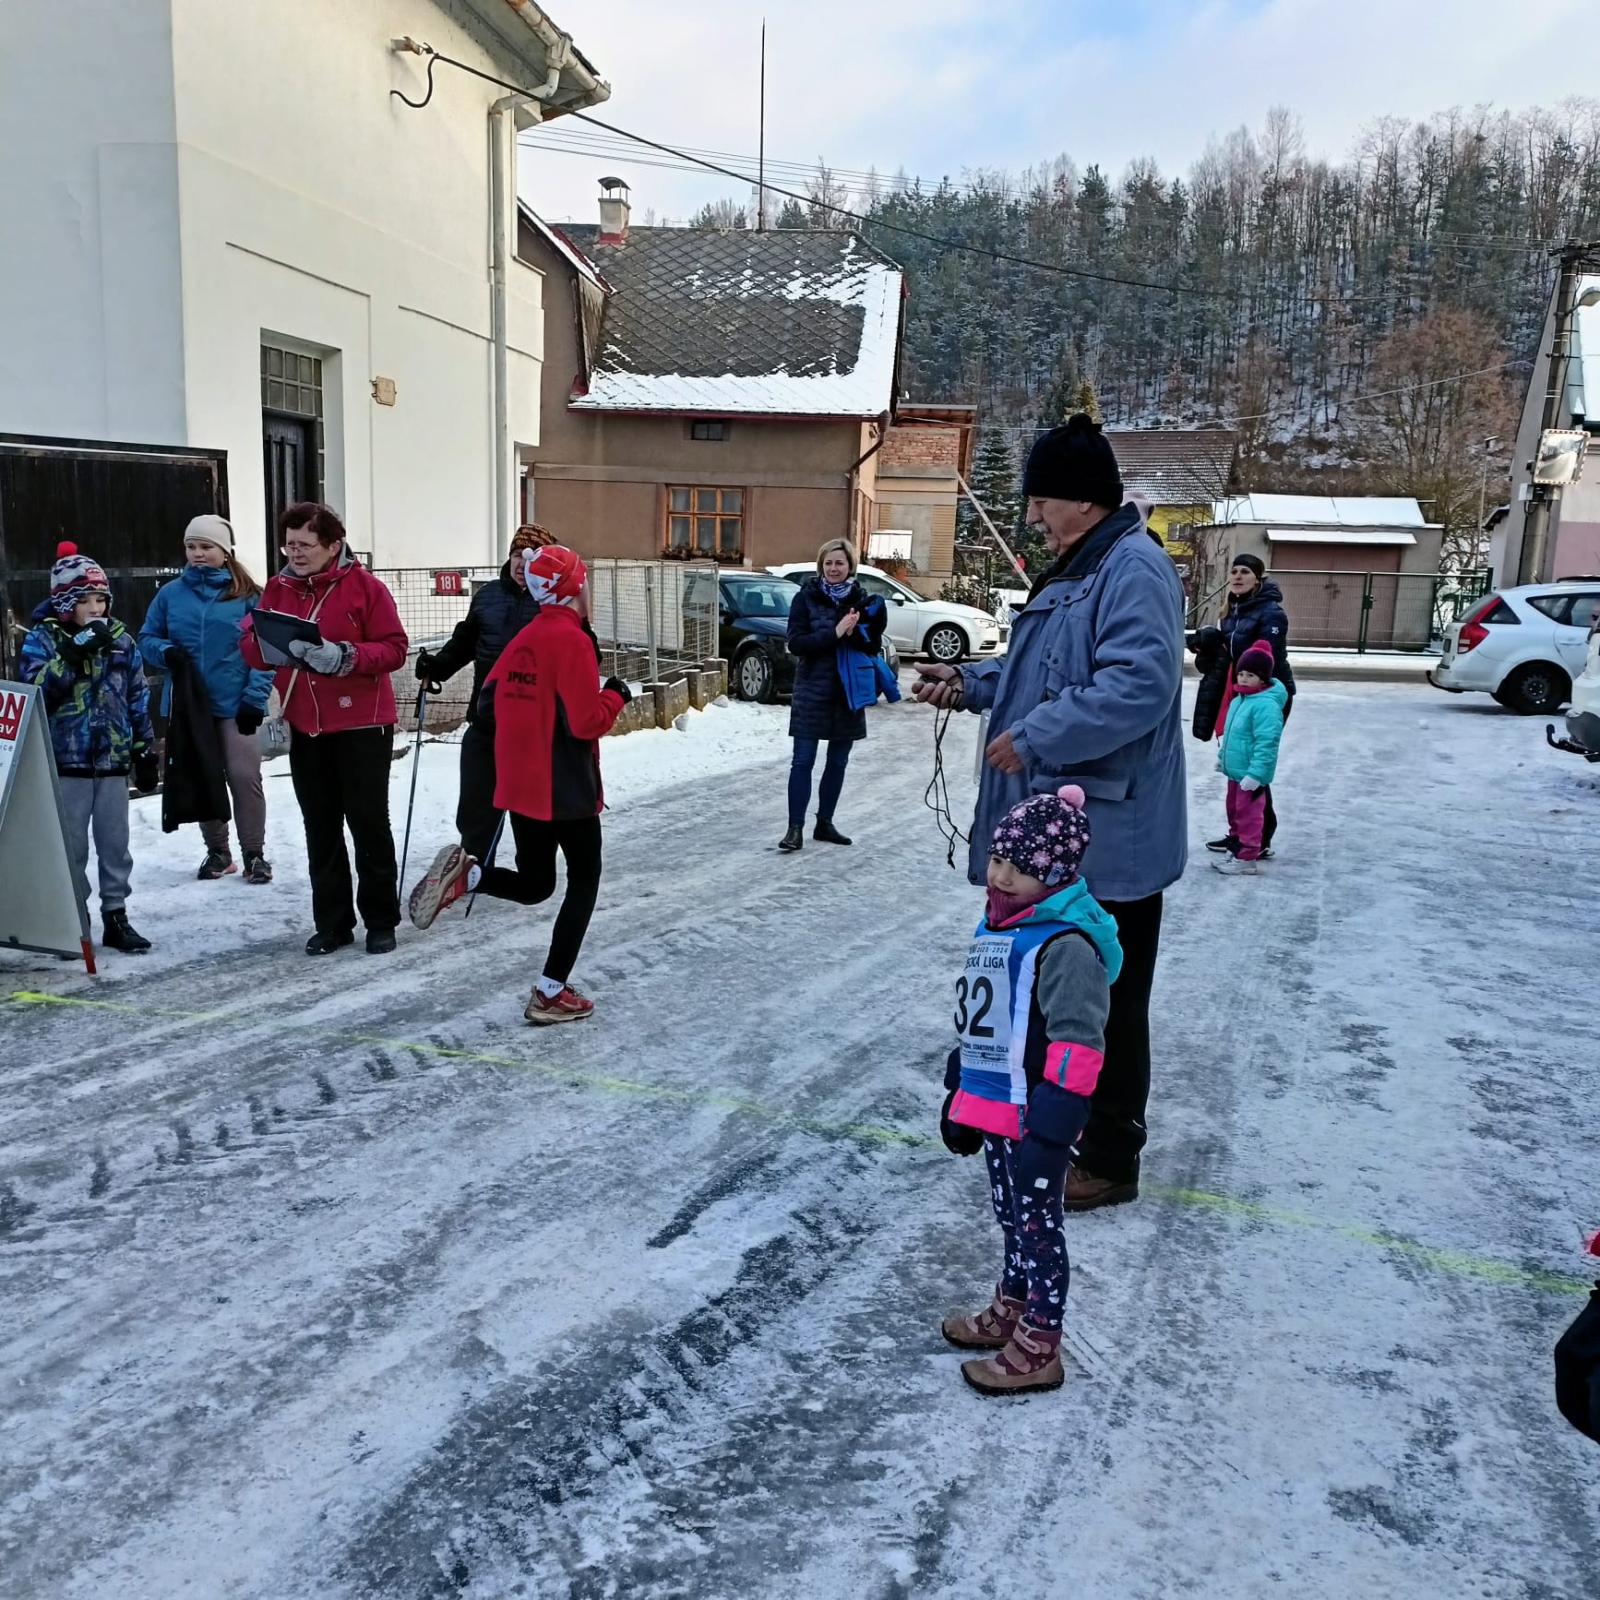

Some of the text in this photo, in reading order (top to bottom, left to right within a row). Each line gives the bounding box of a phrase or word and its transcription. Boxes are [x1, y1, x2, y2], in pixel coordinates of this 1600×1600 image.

[440, 576, 457, 590] 181
[983, 956, 1005, 969] LIGA
[954, 975, 994, 1038] 32
